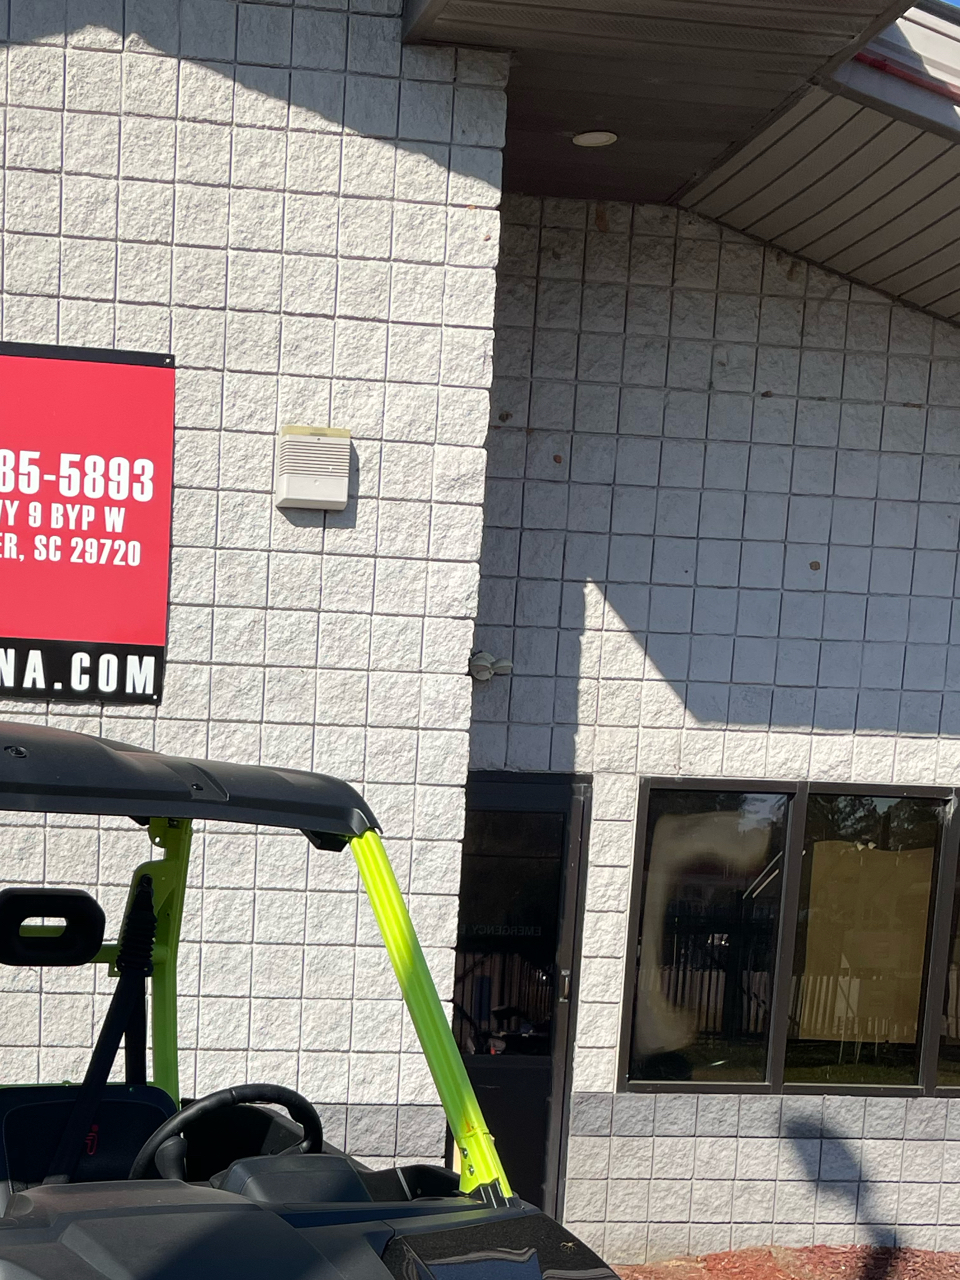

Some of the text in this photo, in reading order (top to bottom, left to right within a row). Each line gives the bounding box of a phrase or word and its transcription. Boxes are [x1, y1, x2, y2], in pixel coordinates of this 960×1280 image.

[28, 501, 42, 528] 9
[50, 502, 96, 531] BYP
[104, 506, 126, 533] W
[33, 534, 62, 562] SC
[70, 537, 141, 567] 29720
